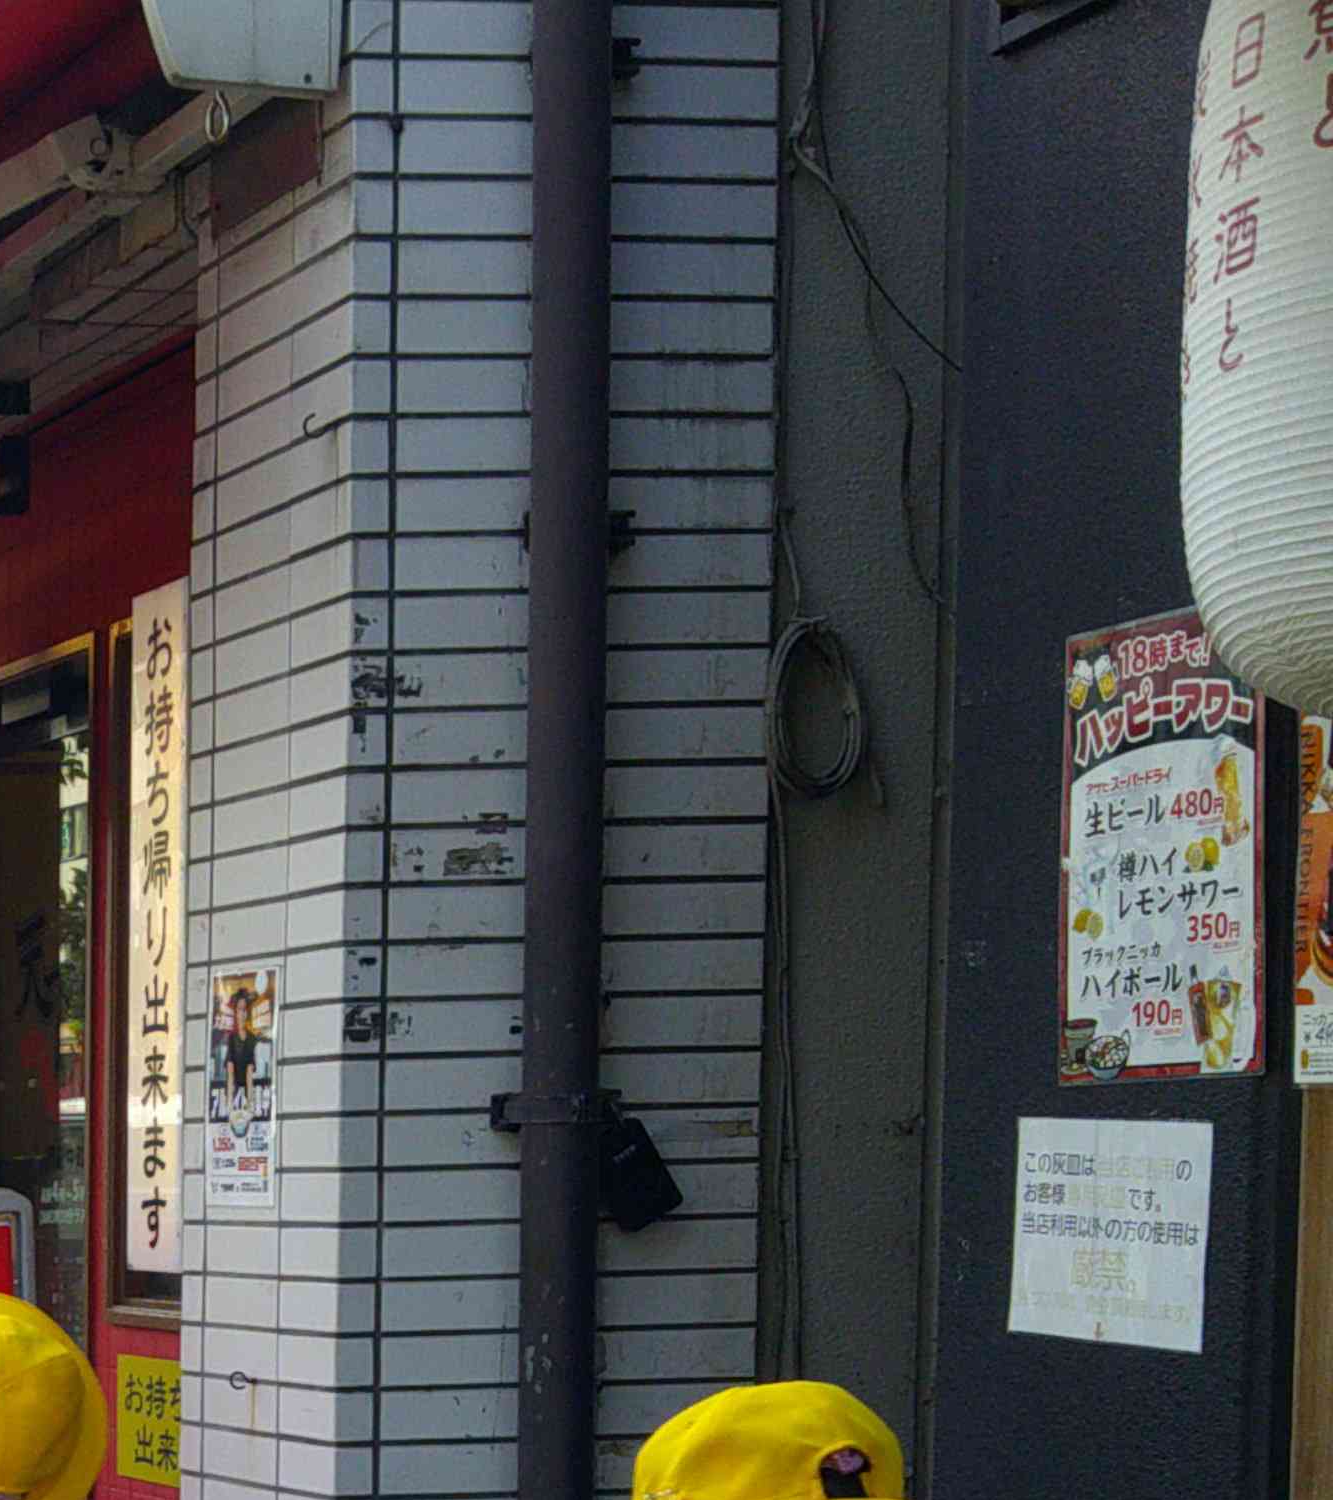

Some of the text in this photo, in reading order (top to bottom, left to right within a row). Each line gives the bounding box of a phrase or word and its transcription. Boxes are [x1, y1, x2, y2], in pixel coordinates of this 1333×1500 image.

[1118, 630, 1212, 678] 18時まで!
[1074, 676, 1254, 767] ハッピーアワー
[1084, 794, 1165, 838] 生ビール
[1119, 879, 1239, 920] レモンサワー
[142, 616, 175, 1250] お持ち帰り出来ます
[1082, 963, 1182, 999] ハイボール
[1132, 999, 1183, 1027] 190円
